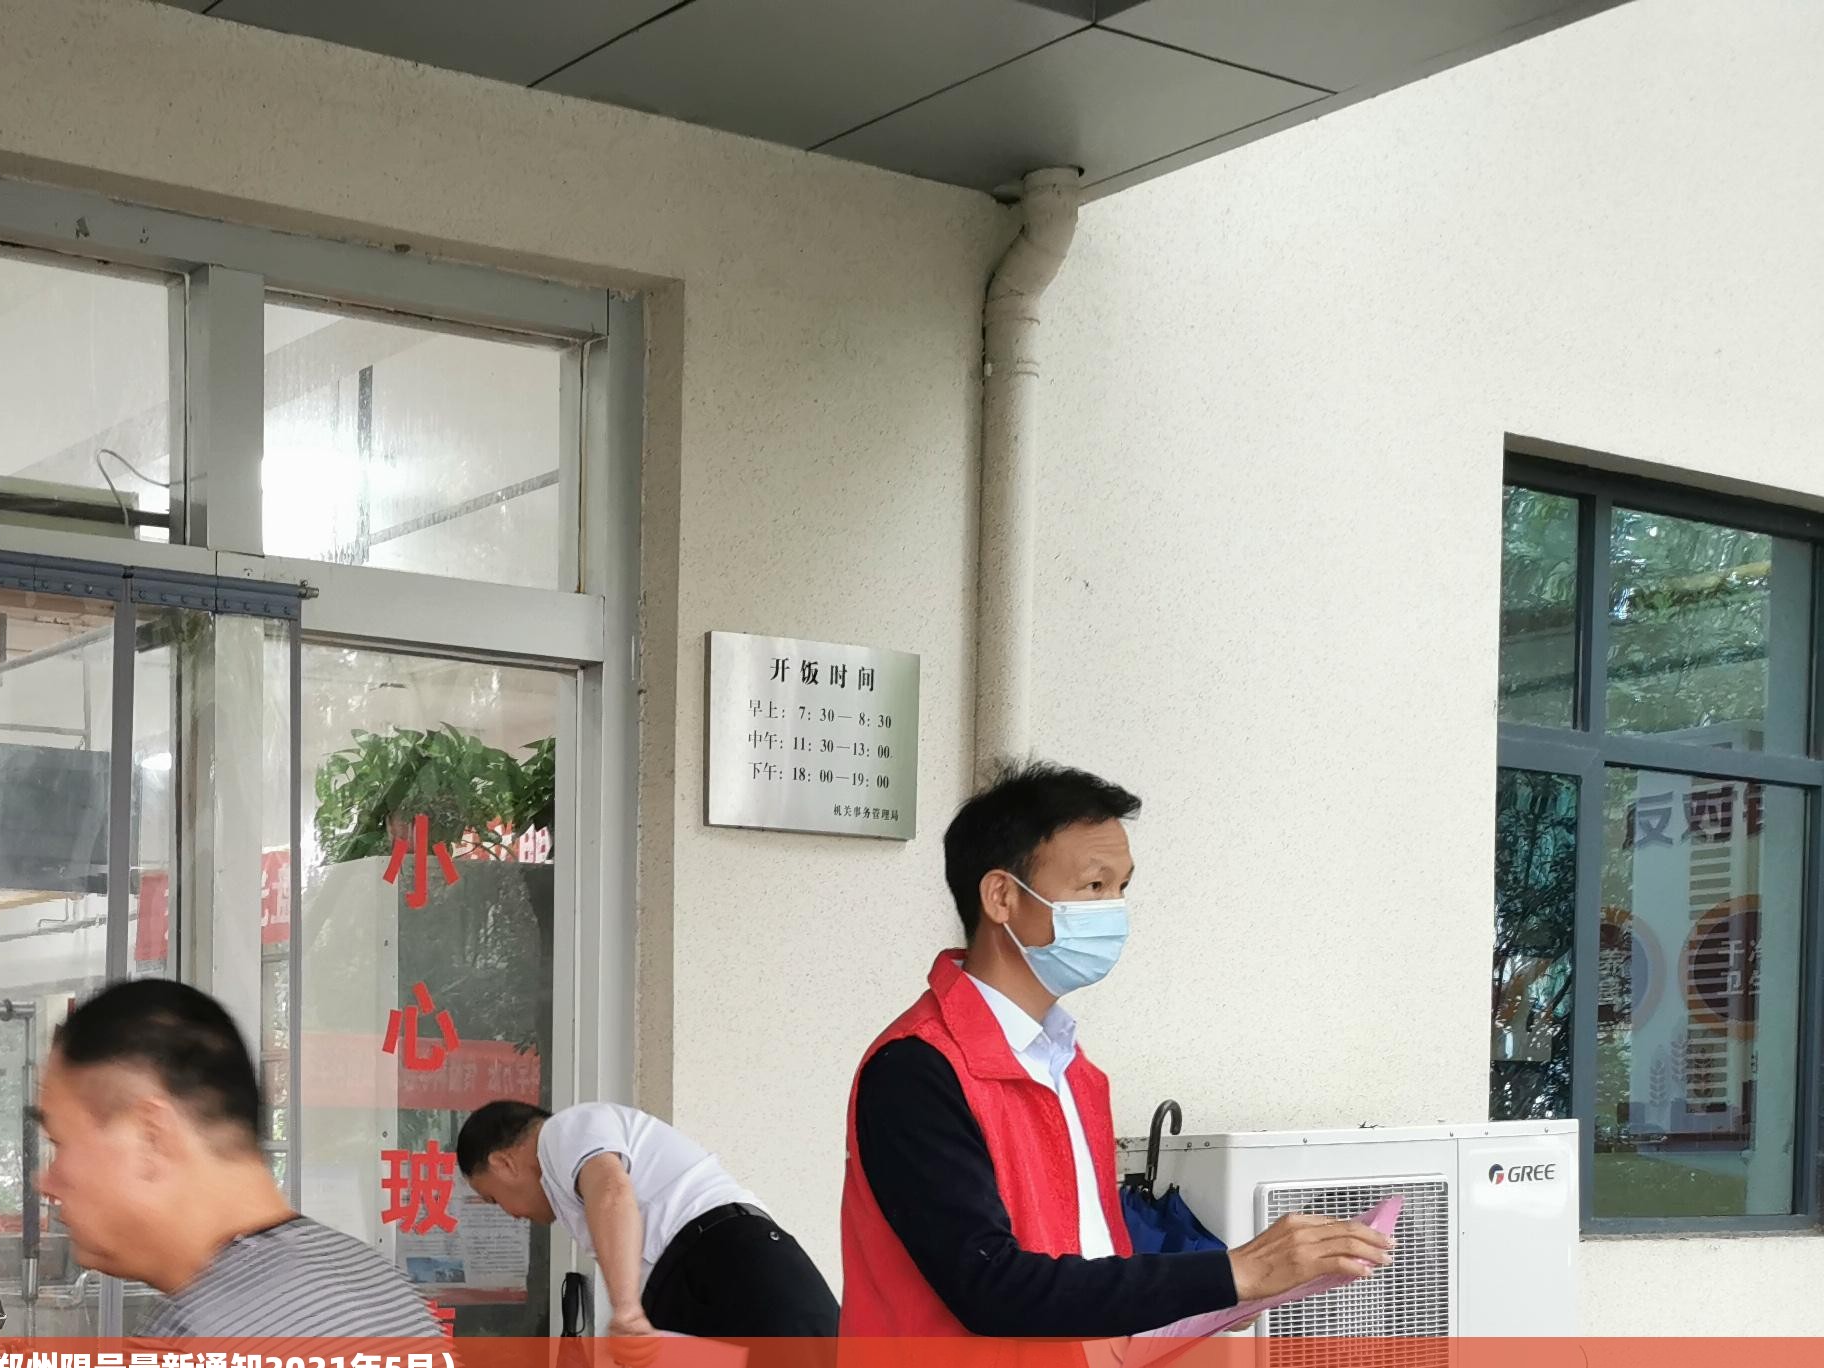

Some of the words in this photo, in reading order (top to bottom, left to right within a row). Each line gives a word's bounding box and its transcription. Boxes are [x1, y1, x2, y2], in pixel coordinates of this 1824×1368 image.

[769, 657, 876, 692] 开饭时间
[832, 803, 900, 822] 机关事务管理局
[381, 813, 460, 1350] 小心玻
[1507, 1163, 1556, 1183] GREE
